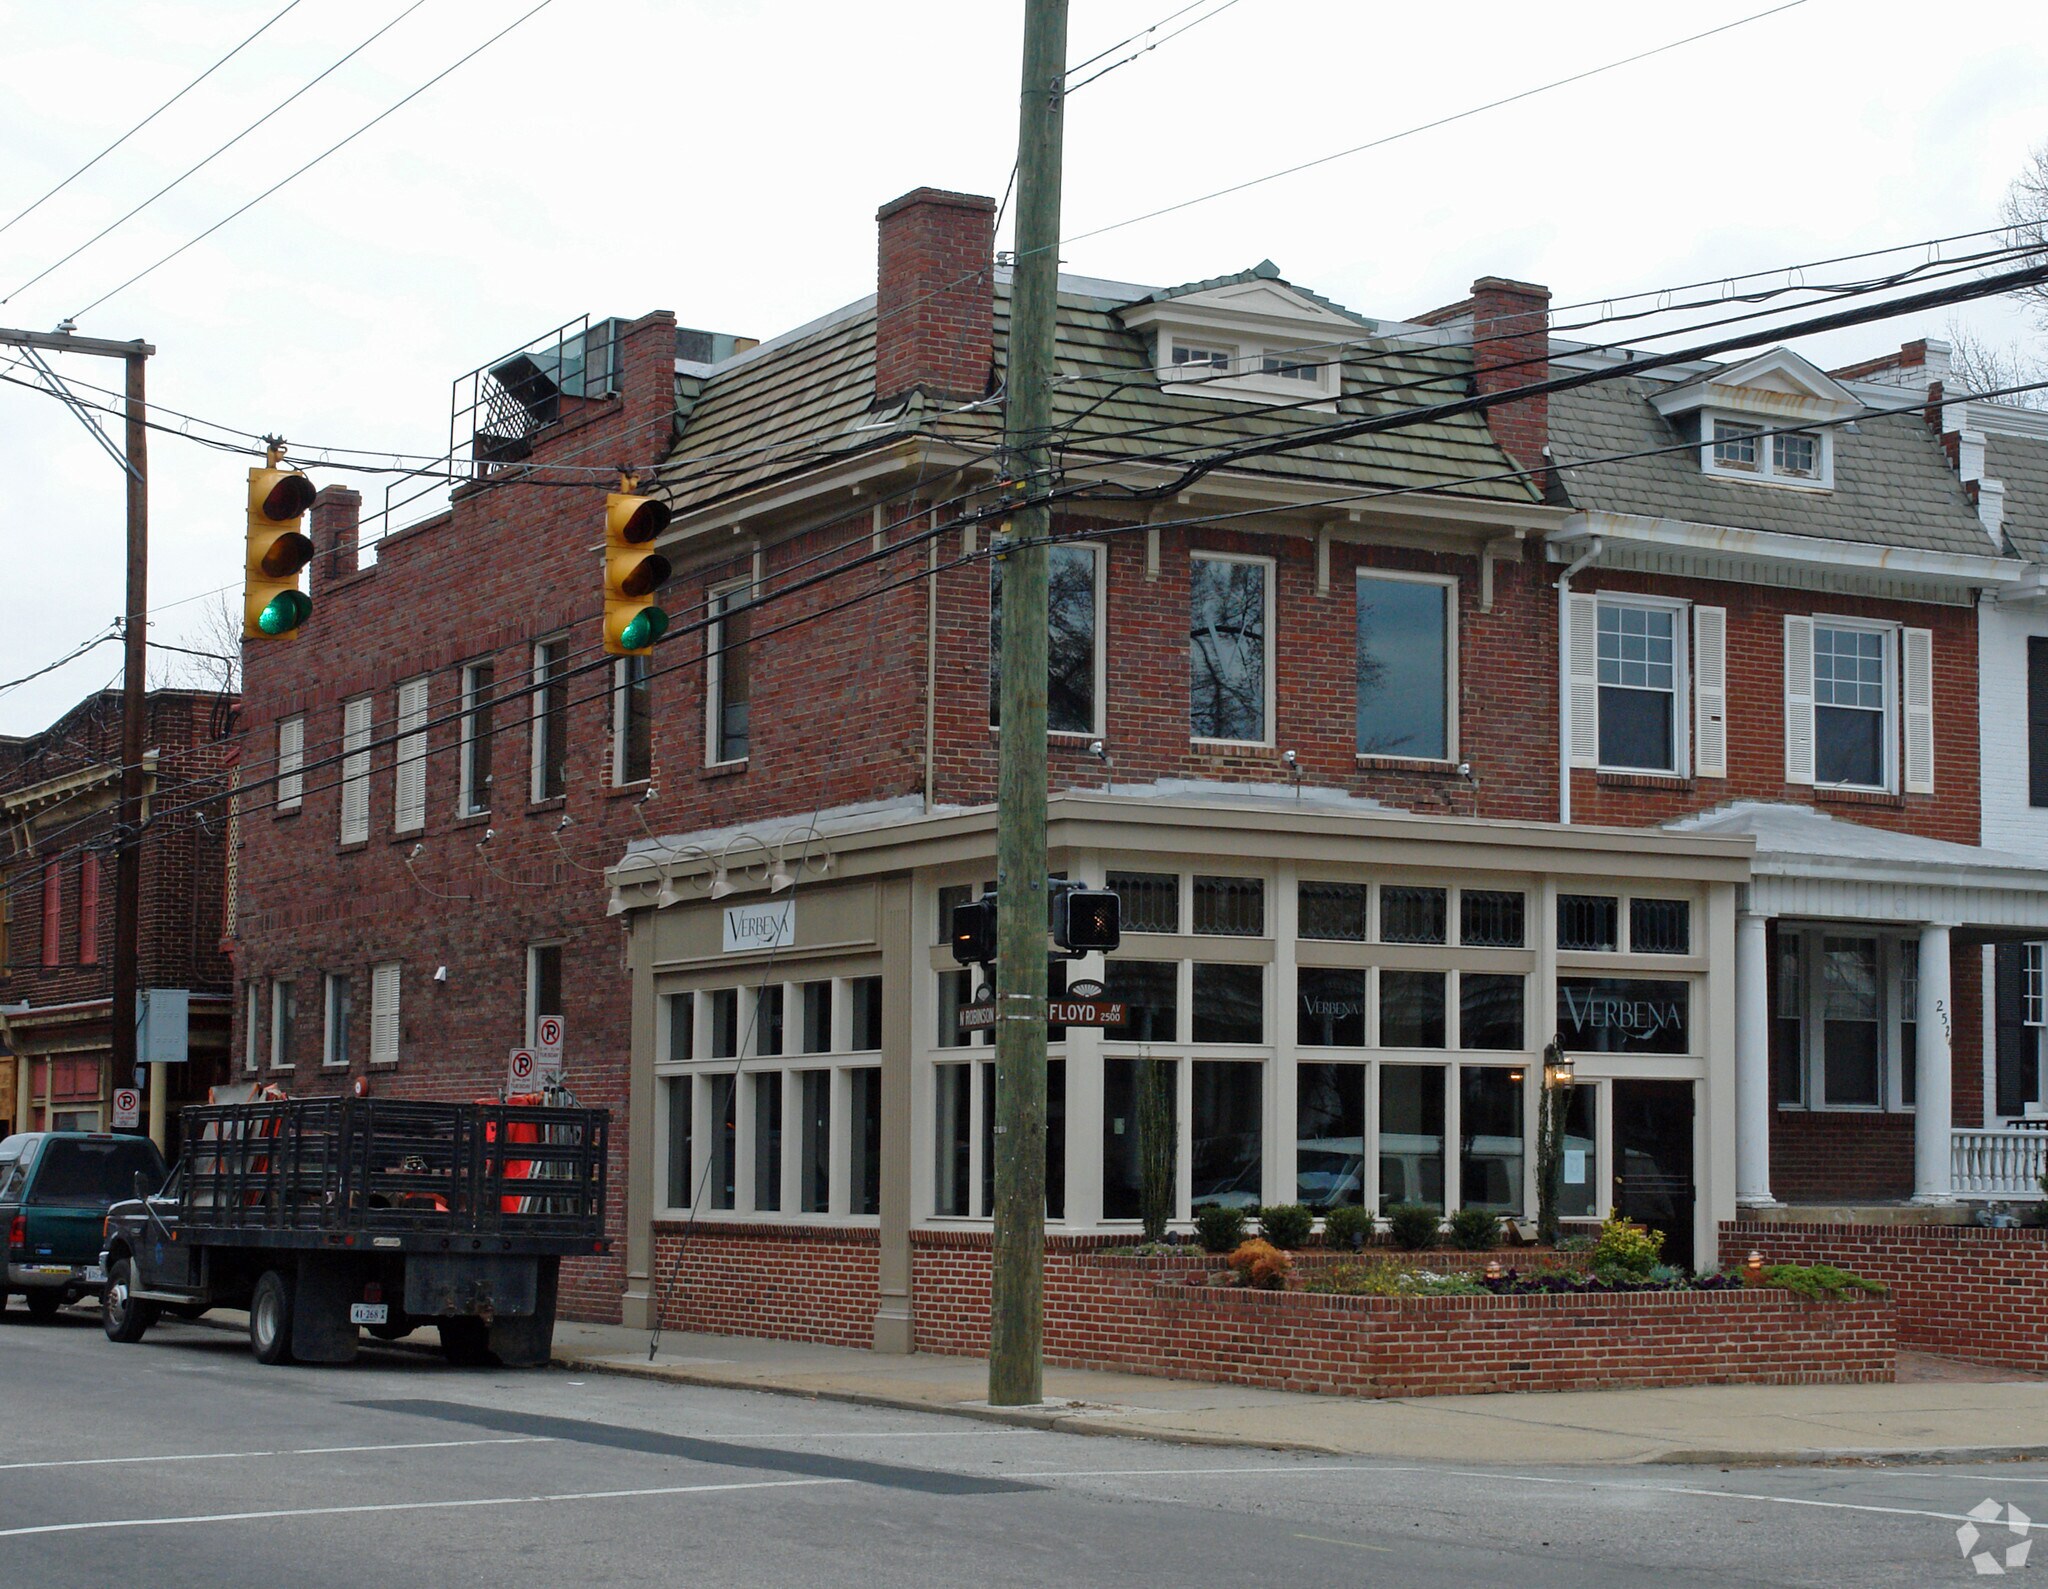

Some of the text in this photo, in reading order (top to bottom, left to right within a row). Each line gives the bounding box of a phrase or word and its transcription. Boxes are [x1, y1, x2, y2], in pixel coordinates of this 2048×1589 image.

[728, 910, 788, 943] VERBENA
[959, 1008, 994, 1026] N ROBINSON
[1050, 1004, 1121, 1021] FLOYD AV
[1100, 1013, 1121, 1022] 2500
[1304, 995, 1358, 1019] VERBENA
[1563, 986, 1681, 1039] VERBENA
